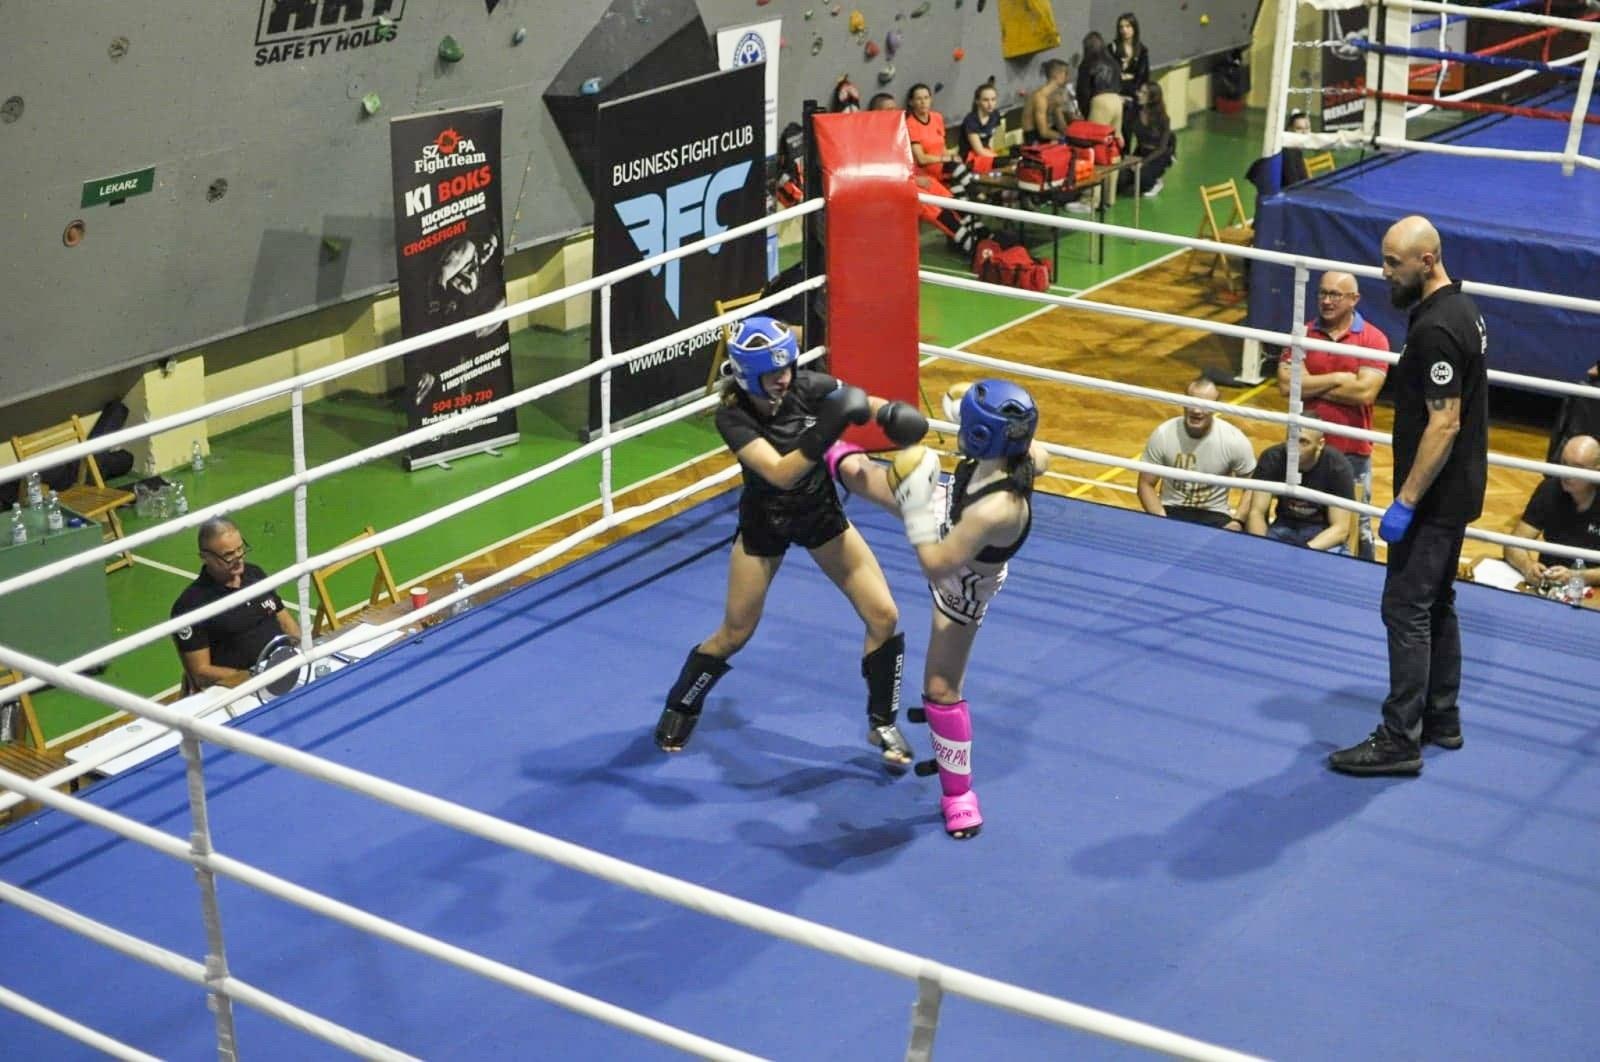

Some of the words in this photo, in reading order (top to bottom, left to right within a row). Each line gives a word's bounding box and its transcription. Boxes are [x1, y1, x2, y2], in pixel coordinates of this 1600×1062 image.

[255, 37, 333, 66] SAFETY
[613, 148, 679, 186] BUSINESS
[681, 136, 719, 166] FIGHT
[720, 125, 753, 152] CLUB
[100, 178, 138, 196] LEKARZ
[437, 166, 492, 203] BOKS
[421, 192, 486, 228] KICKBOXING
[403, 220, 468, 256] CROSSFIGHT
